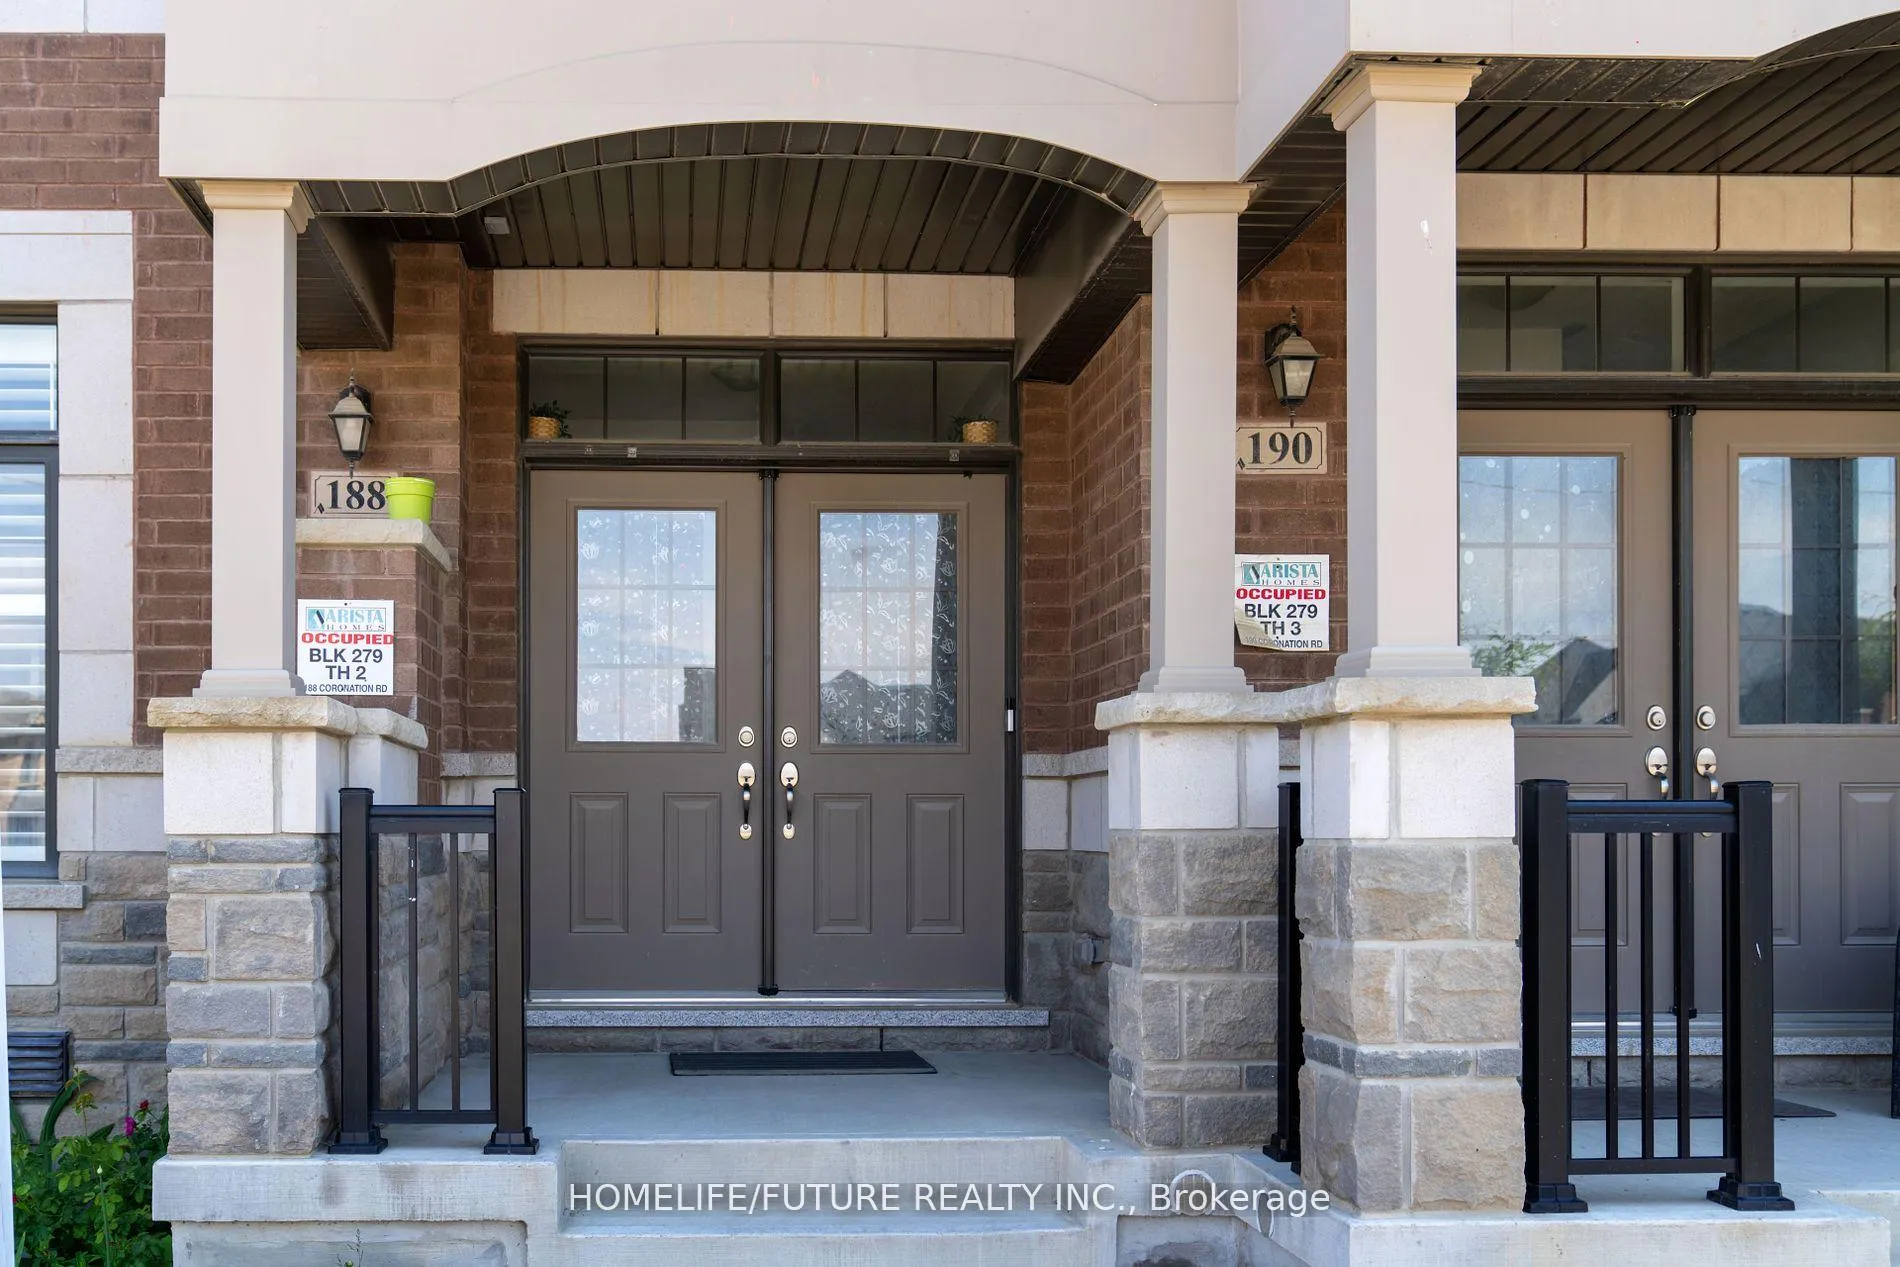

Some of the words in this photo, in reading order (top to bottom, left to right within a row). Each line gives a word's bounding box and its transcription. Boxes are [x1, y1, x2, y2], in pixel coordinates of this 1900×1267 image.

[1248, 432, 1313, 465] 190
[327, 480, 386, 510] 188
[1261, 563, 1319, 578] ARISTA
[1236, 588, 1326, 600] OCCUPIED
[326, 608, 384, 623] ARISTA
[1244, 604, 1281, 618] BLK
[1286, 604, 1318, 618] 279
[1260, 621, 1285, 635] TH
[1290, 621, 1302, 635] 3
[301, 632, 394, 645] OCCUPIED
[1310, 640, 1323, 648] RD
[309, 648, 347, 663] BLK
[352, 648, 383, 663] 279
[325, 666, 350, 680] TH
[355, 666, 367, 680] 2
[319, 684, 374, 693] CORONATION
[375, 684, 388, 693] RD
